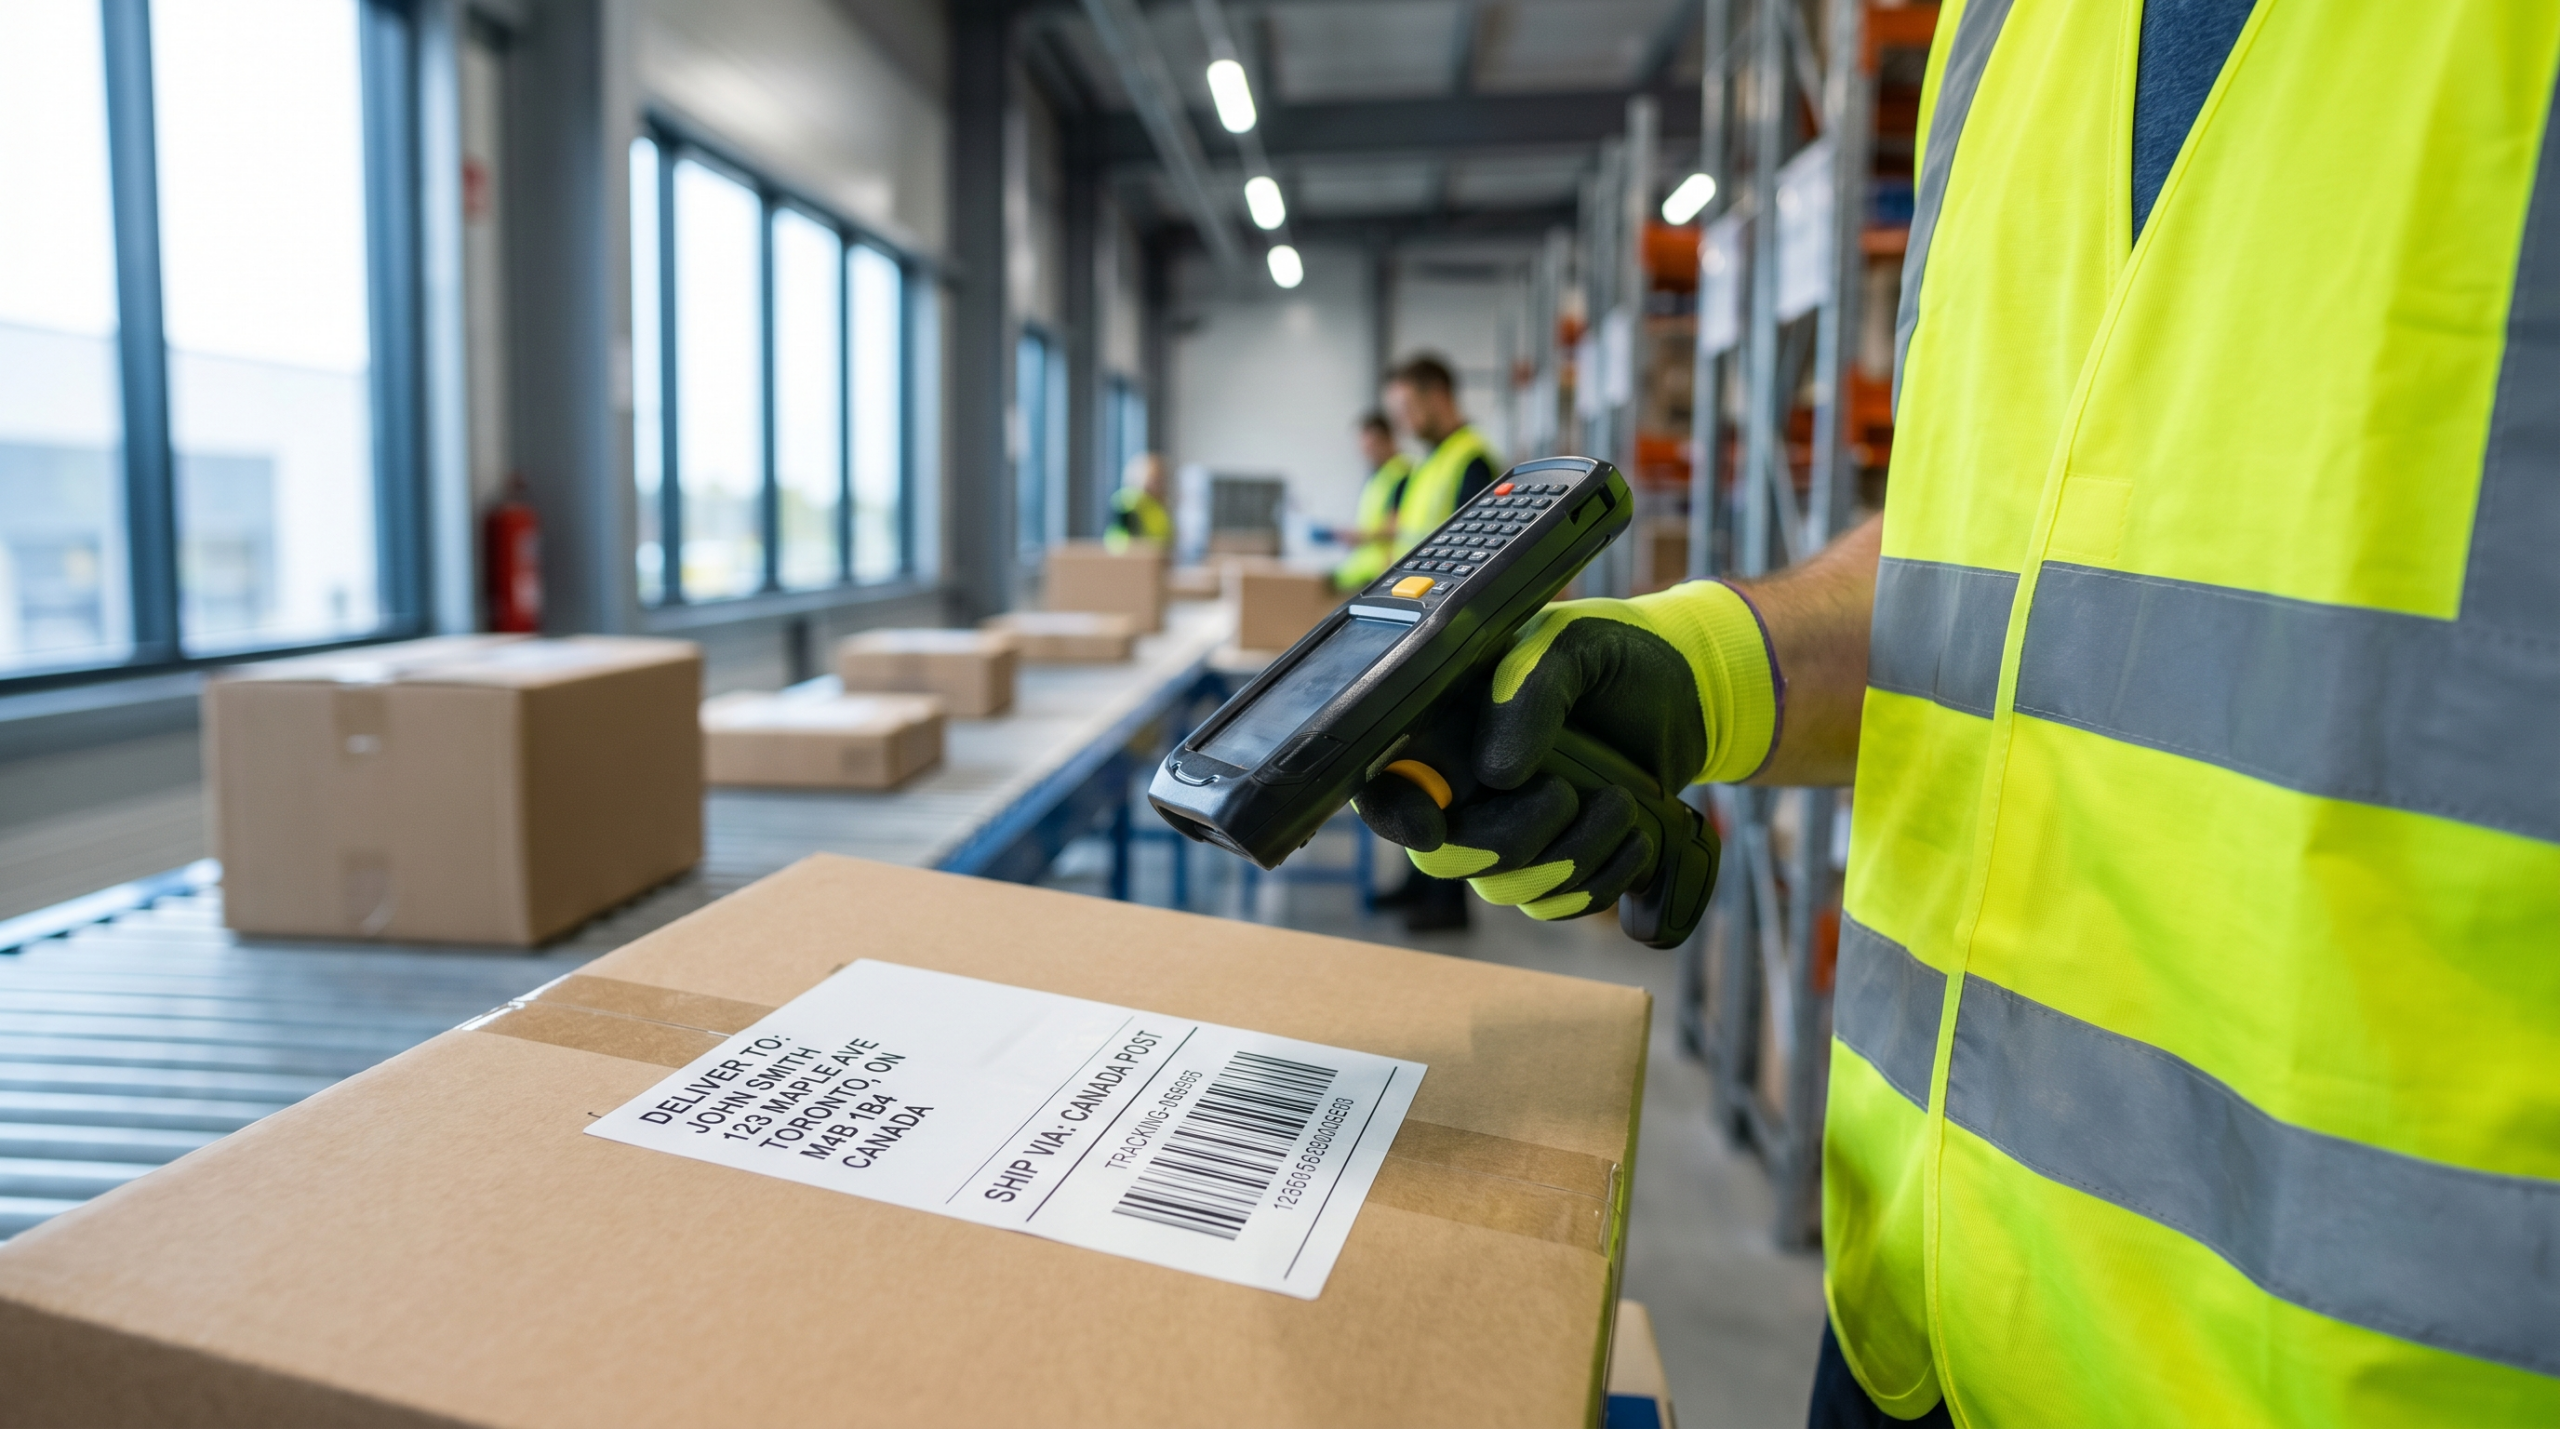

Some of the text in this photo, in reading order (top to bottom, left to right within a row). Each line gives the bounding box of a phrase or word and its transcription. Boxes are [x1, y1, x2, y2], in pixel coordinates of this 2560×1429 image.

[639, 1034, 791, 1125] DELIVER TO:
[686, 1046, 822, 1134] JOHN SMITH
[723, 1038, 880, 1140] 123 MAPLE AVE
[758, 1051, 907, 1150] TORONTO, ON
[984, 1030, 1163, 1203] SHIP VIA: CANADA POST
[799, 1093, 898, 1160] M4B 1B4
[842, 1104, 935, 1169] CANADA
